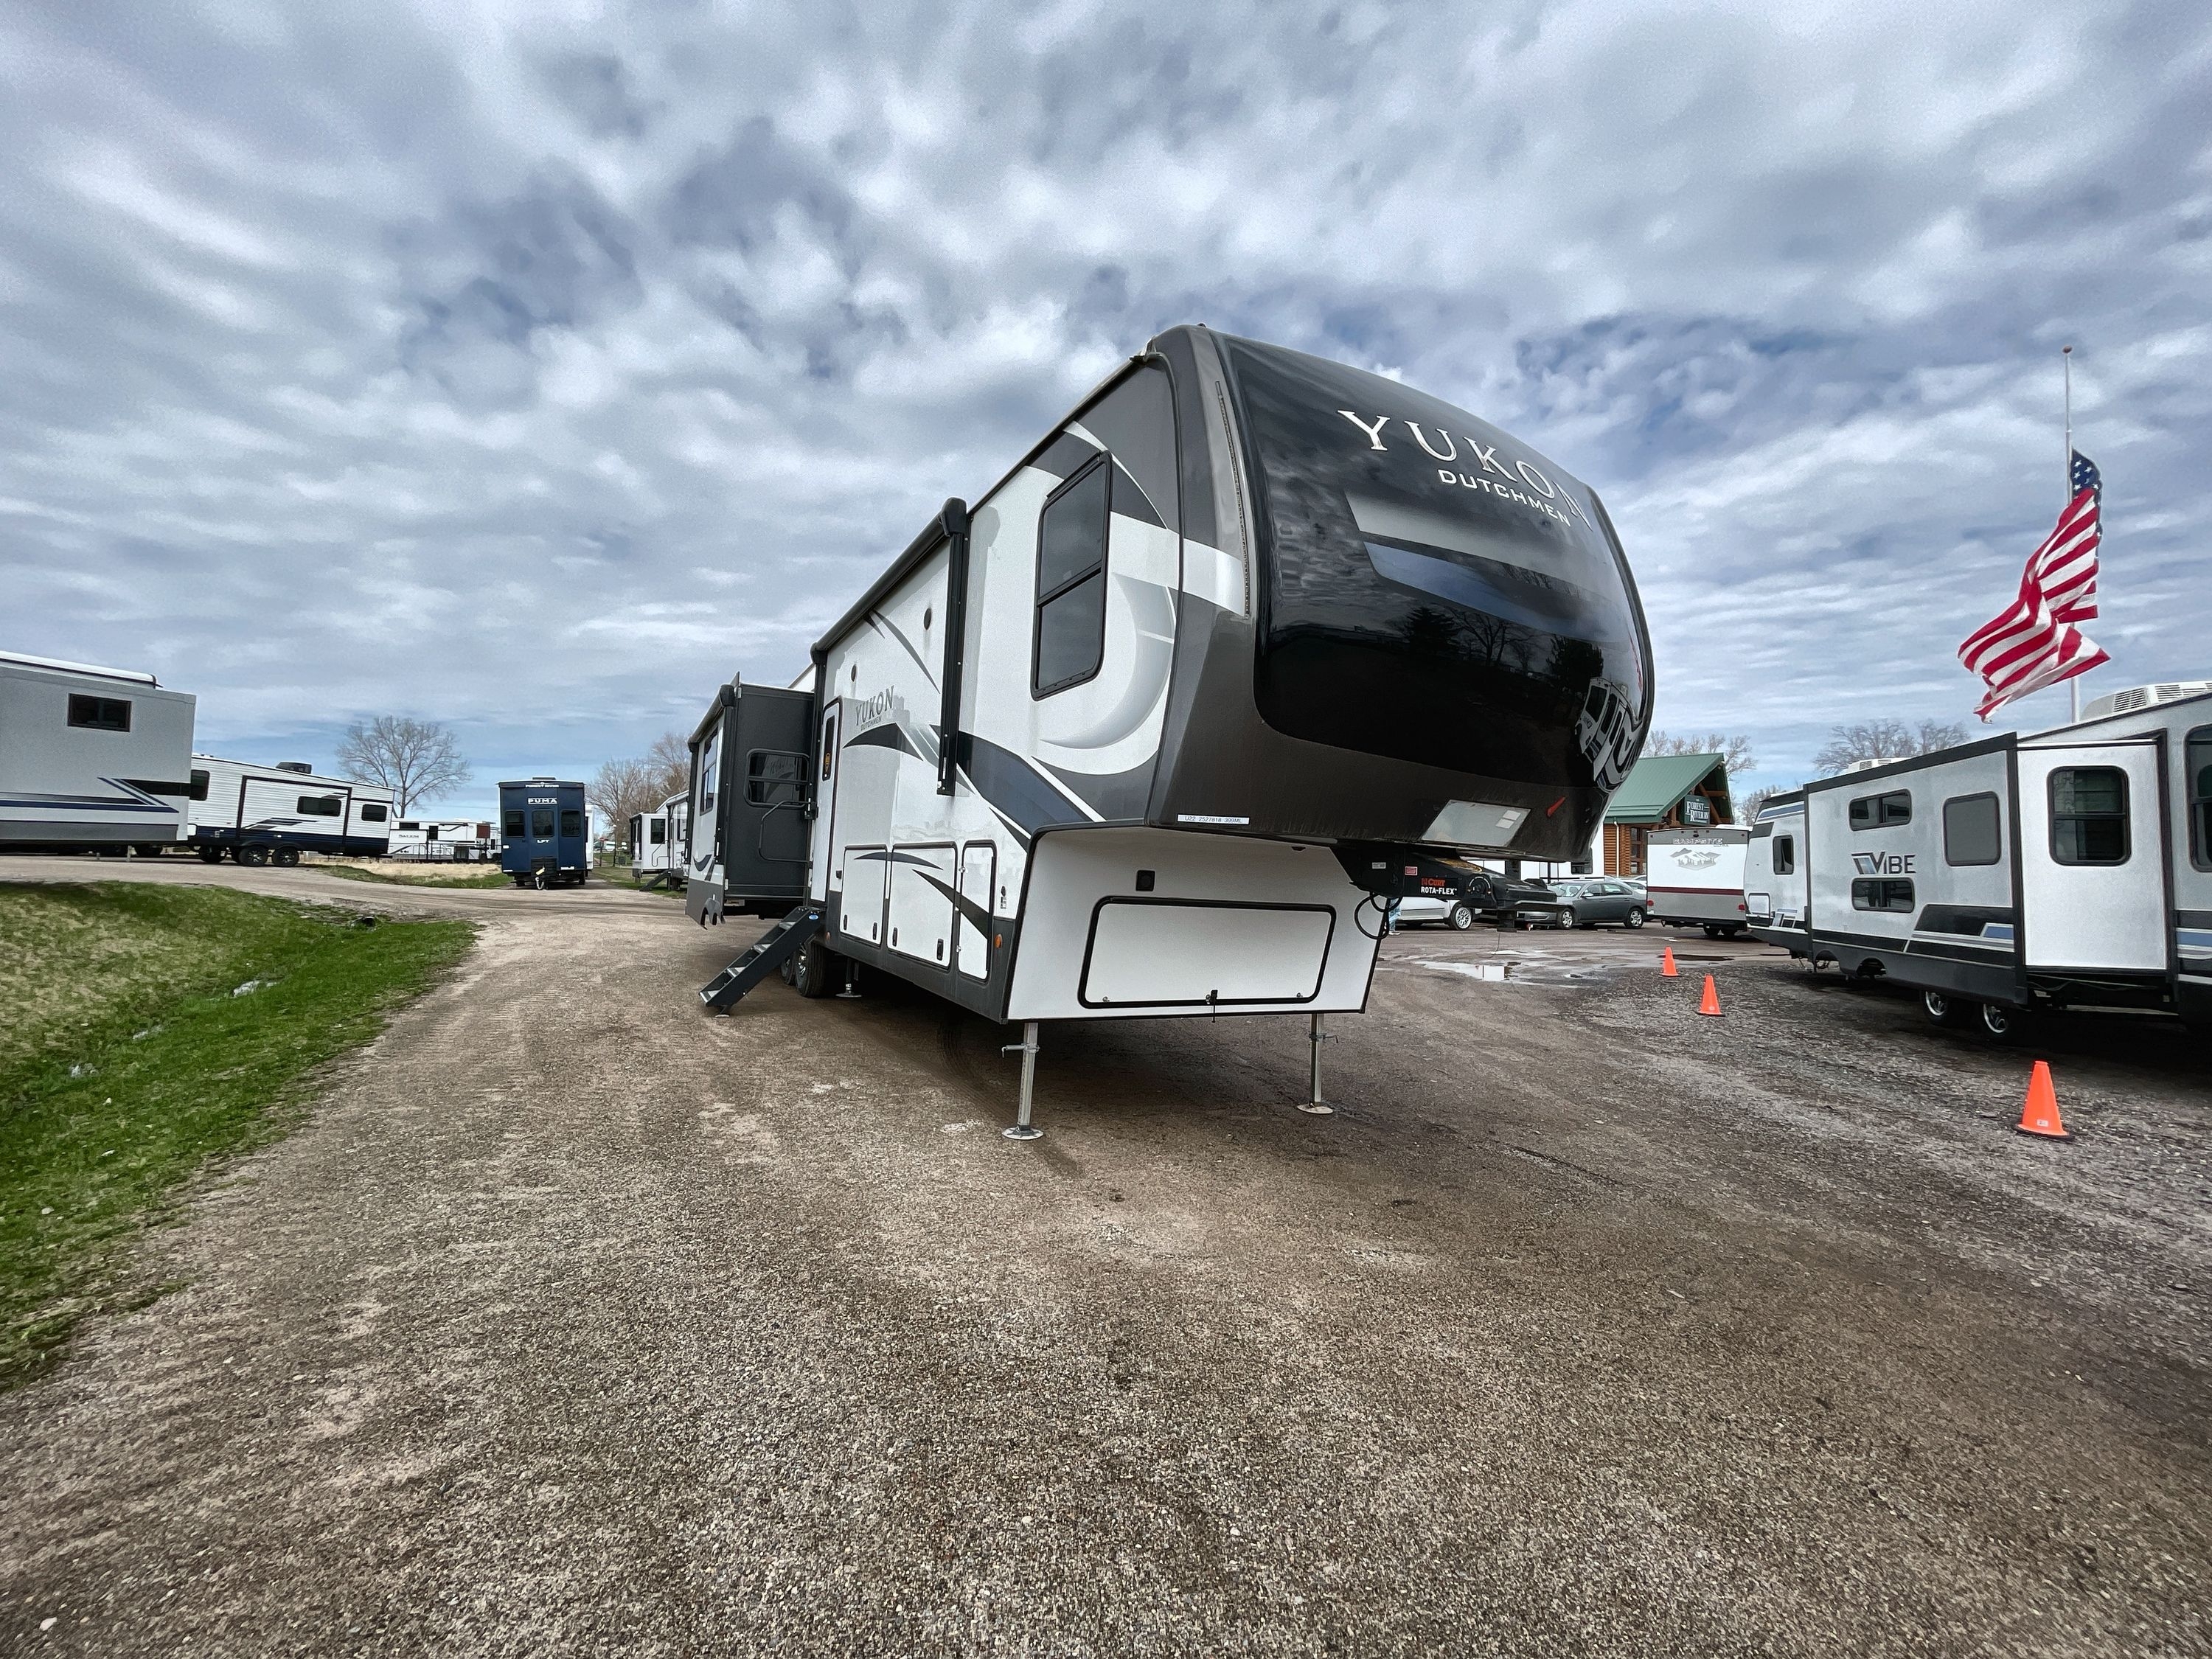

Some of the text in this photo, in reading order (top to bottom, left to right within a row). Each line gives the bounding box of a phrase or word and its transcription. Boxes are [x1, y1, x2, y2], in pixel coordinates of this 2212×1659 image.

[1338, 409, 1593, 532] YUKON
[1437, 468, 1571, 527] DUTCHMEN
[855, 684, 894, 726] YUKON
[1427, 877, 1446, 887] CURT
[1851, 851, 1916, 874] VIBE
